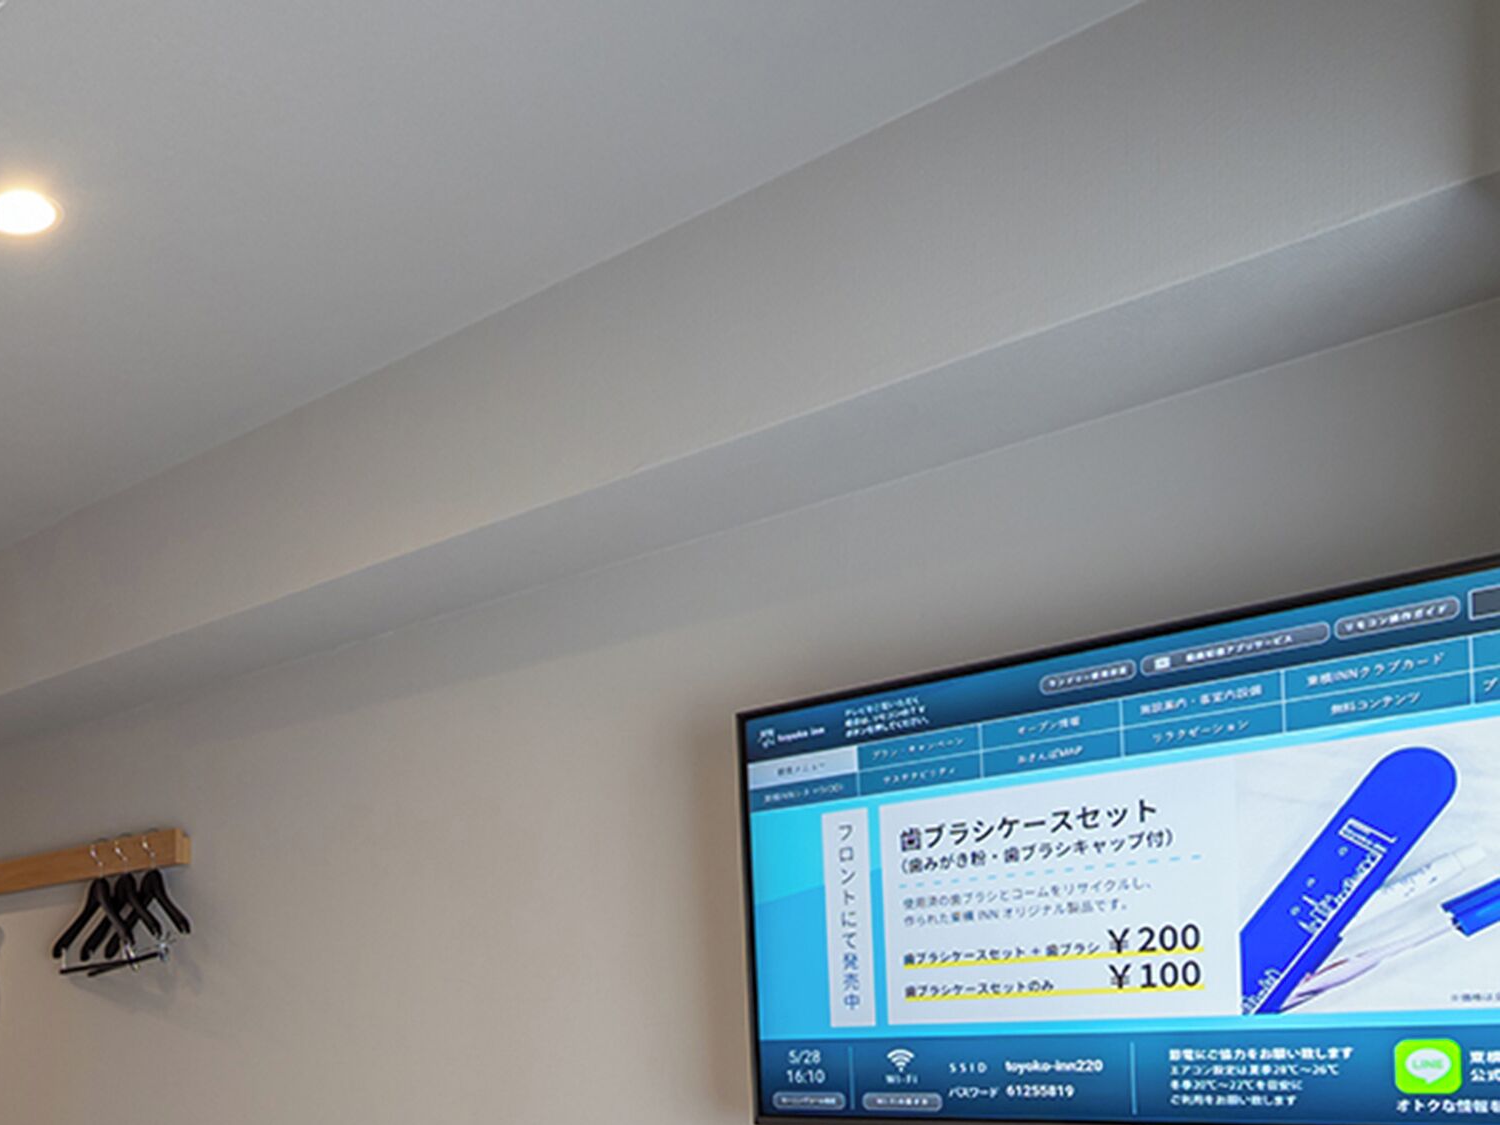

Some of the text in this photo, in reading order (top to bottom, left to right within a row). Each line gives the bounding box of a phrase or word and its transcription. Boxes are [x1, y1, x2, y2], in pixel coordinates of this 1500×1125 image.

[1152, 720, 1250, 744] リラクゼーション
[900, 798, 1158, 852] 歯ブラシケースセット
[839, 824, 861, 1011] フロントにて発売中
[904, 947, 1025, 966] 歯ブラシケースセット
[1046, 941, 1101, 958] 歯ブラシ
[905, 979, 1054, 998] 歯ブラシケースセットのみ
[788, 1049, 822, 1066] 5/28
[1168, 1046, 1354, 1062] 節電にご協力をお願い致します
[1005, 1059, 1104, 1076] toyoko-inn220
[1411, 1058, 1445, 1071] LINE
[786, 1069, 827, 1085] 16:10
[949, 1085, 1075, 1099] パスワード 61255819
